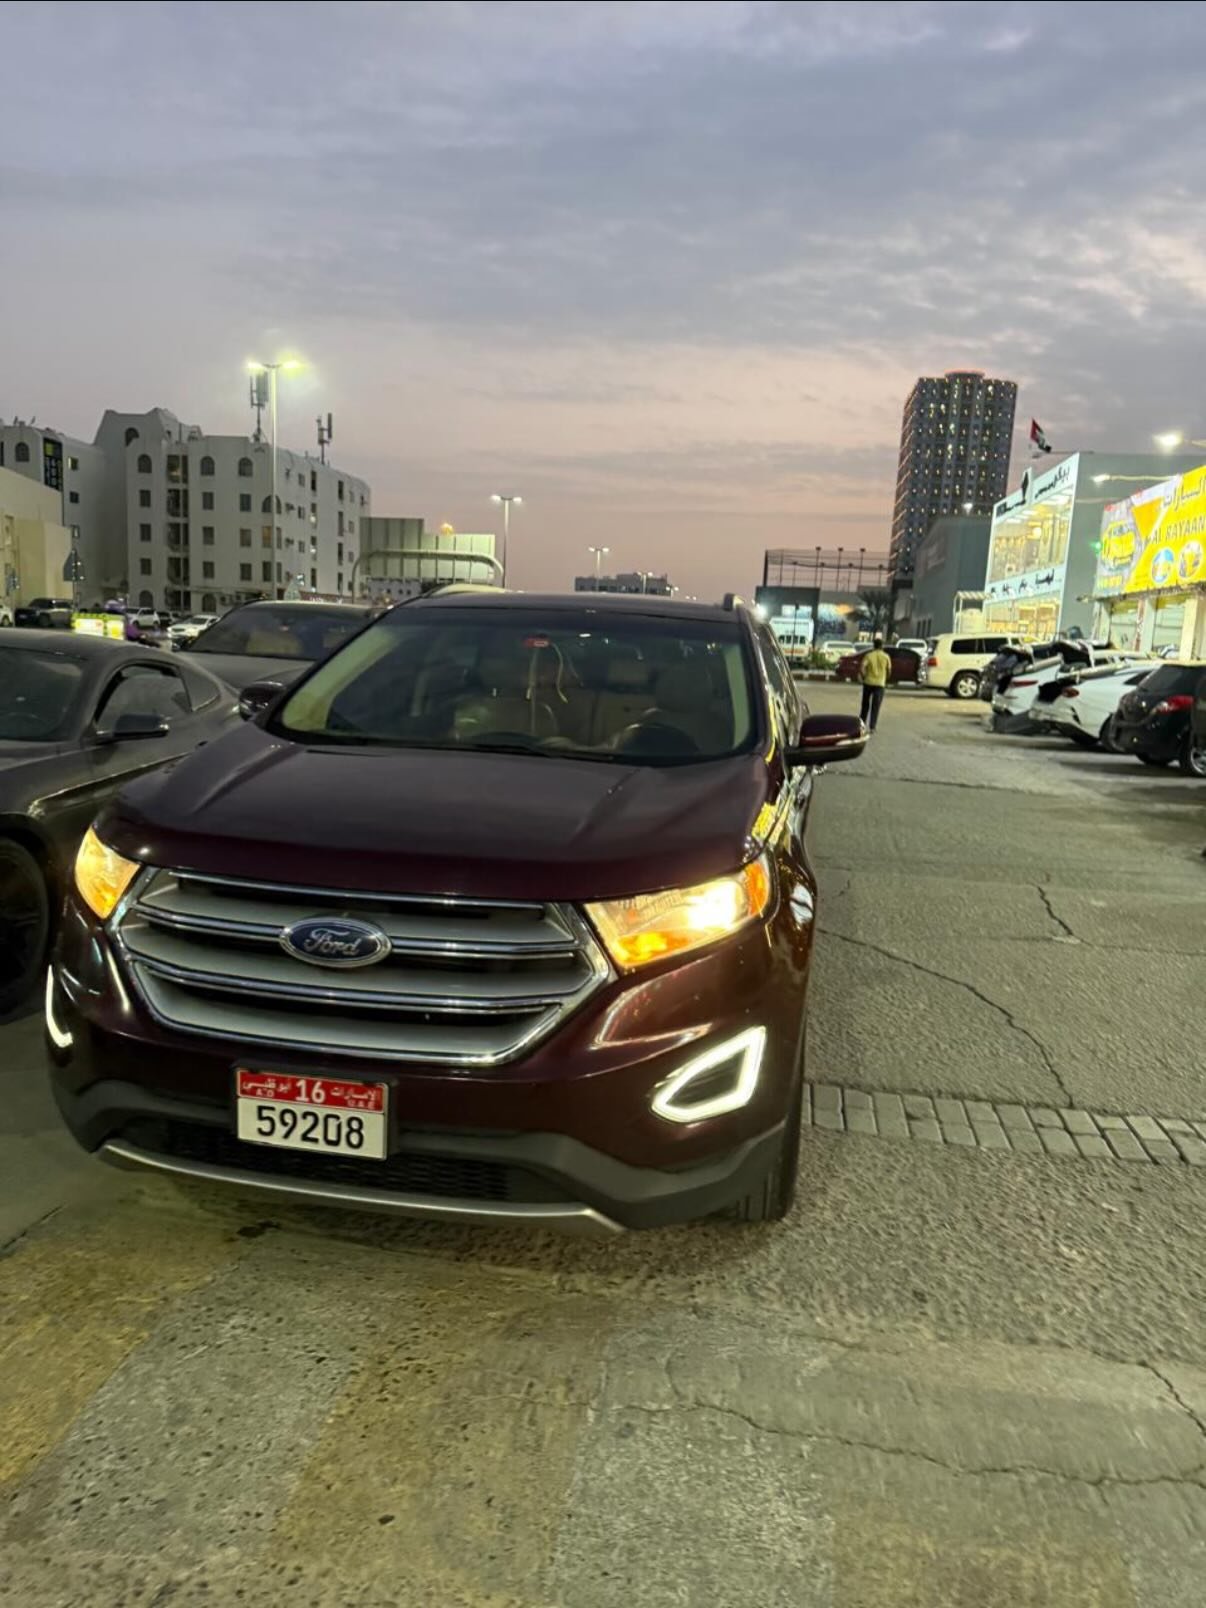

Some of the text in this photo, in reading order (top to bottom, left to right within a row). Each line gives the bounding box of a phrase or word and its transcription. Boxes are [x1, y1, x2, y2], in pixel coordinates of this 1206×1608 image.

[304, 928, 362, 955] Ford
[295, 1079, 326, 1103] 16
[256, 1105, 365, 1149] 59208
